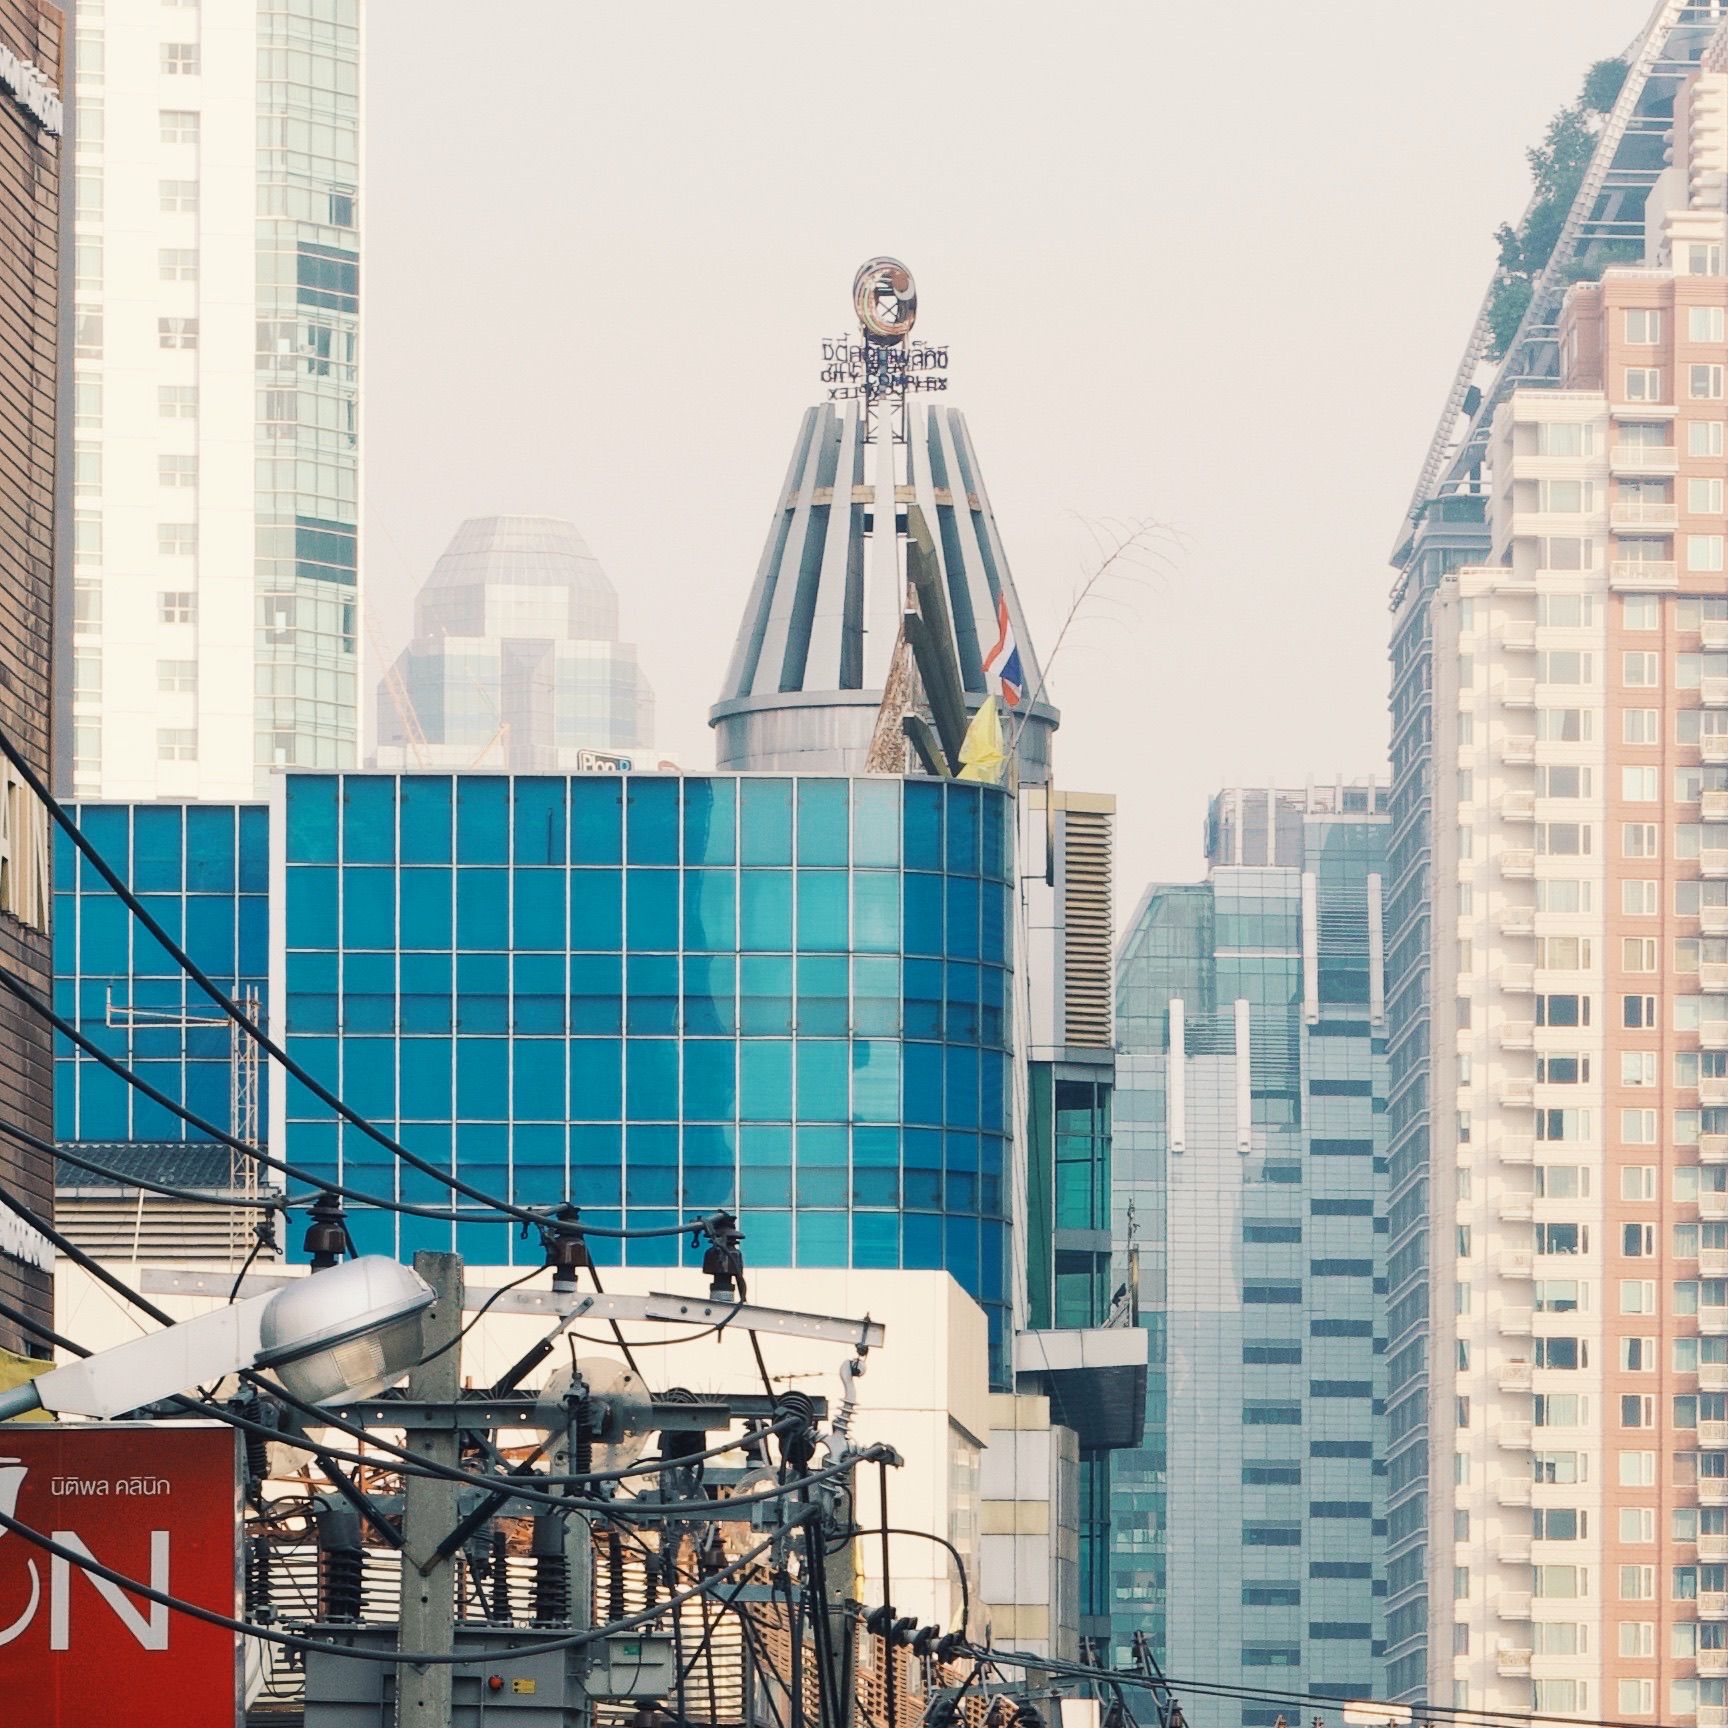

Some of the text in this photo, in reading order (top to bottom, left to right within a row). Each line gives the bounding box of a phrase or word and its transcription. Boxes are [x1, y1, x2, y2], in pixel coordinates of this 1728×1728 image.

[50, 1477, 171, 1496] นิติพล คลินิก
[0, 1530, 170, 1651] N
